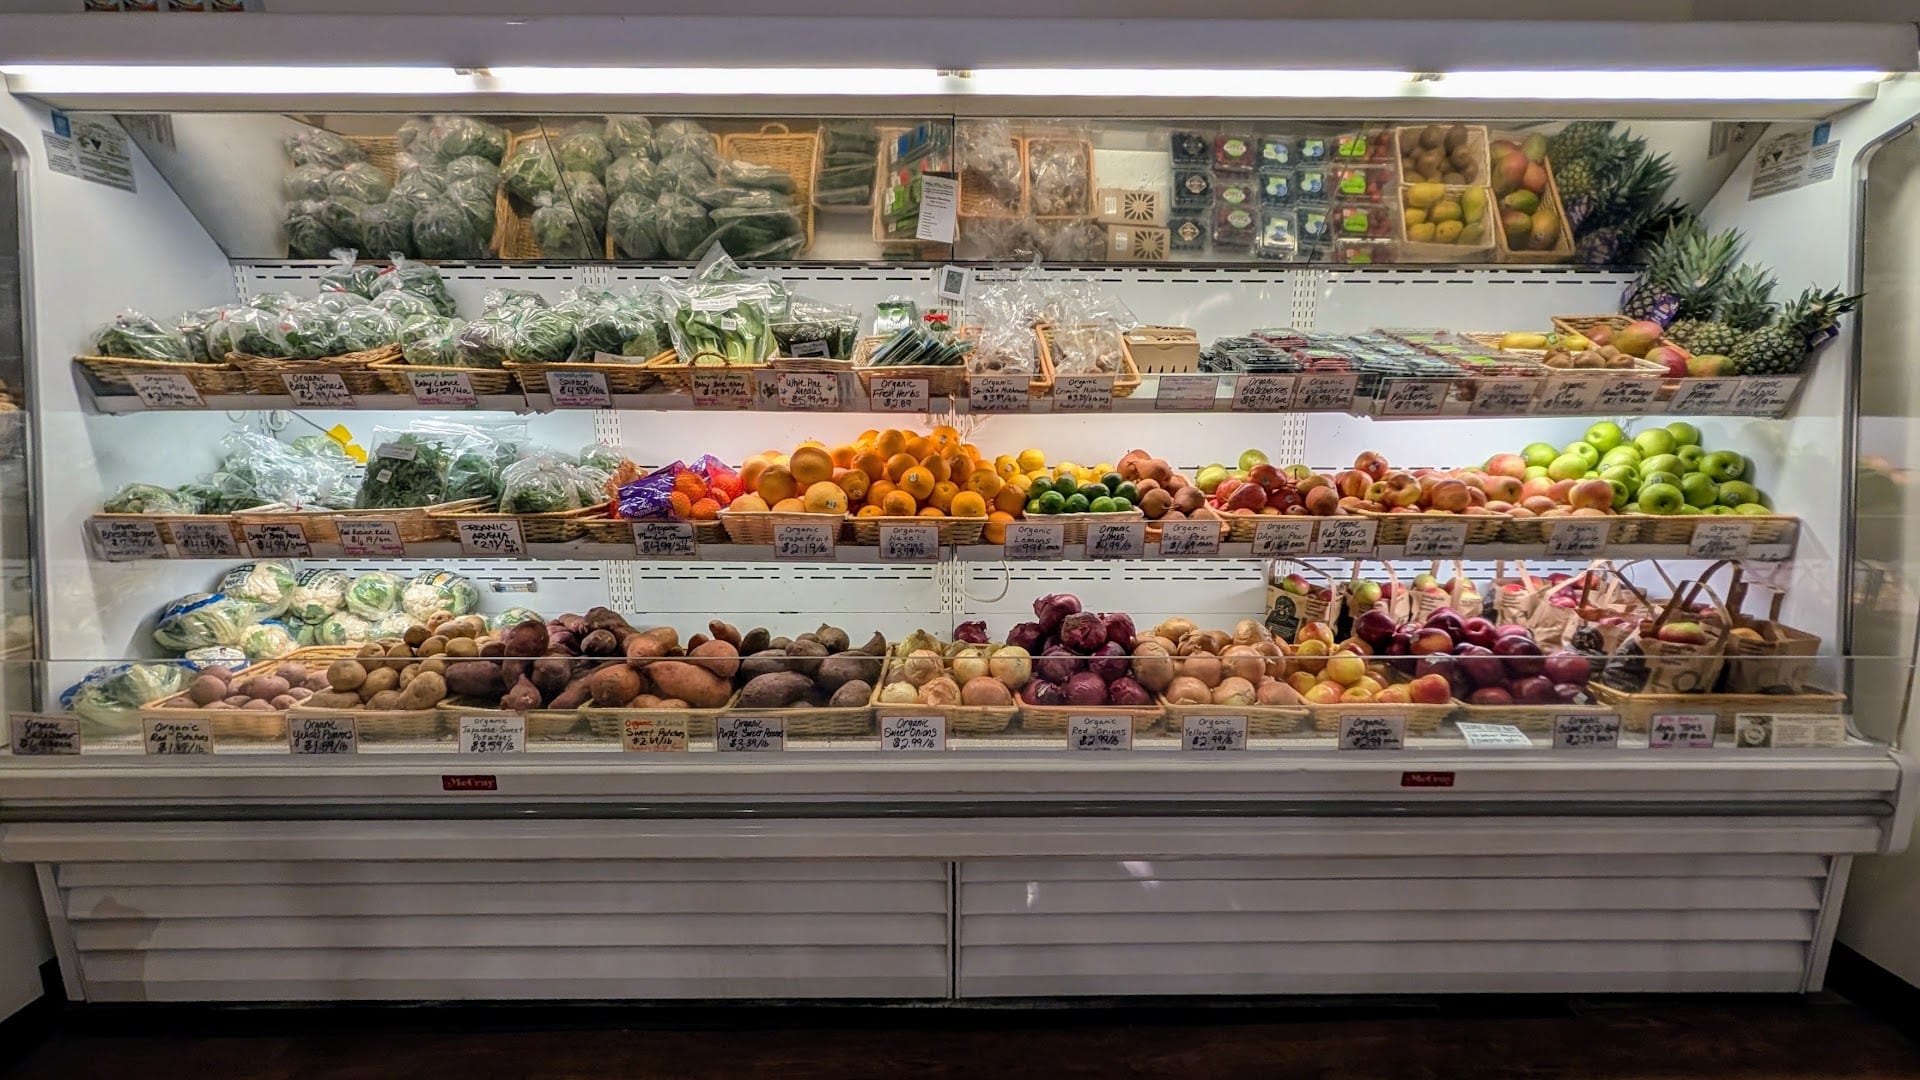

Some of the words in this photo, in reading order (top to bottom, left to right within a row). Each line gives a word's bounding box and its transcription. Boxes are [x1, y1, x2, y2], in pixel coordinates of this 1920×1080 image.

[293, 375, 327, 384] Organic
[415, 379, 432, 388] Baby
[560, 378, 588, 387] Spinach
[982, 379, 1012, 387] Organic
[1069, 379, 1096, 388] Organic
[1249, 378, 1277, 386] Organic
[1310, 378, 1344, 387] Organic
[290, 382, 310, 393] Baby
[314, 382, 344, 391] Spinach
[881, 380, 916, 390] Organic
[873, 388, 896, 398] Fresh
[897, 388, 920, 398] Herbs
[884, 400, 912, 409] $2.89
[786, 526, 819, 535] Organic
[893, 527, 927, 536] Organic
[1018, 526, 1052, 536] Organic
[1099, 524, 1130, 534] Organic
[1173, 523, 1208, 533] Organic
[1267, 523, 1301, 532] Organic
[1322, 529, 1336, 538] Red
[1339, 528, 1366, 538] Pears
[779, 535, 829, 544] Grapefruit
[1014, 536, 1052, 544] Lemons
[304, 720, 337, 730] Organic
[625, 719, 655, 730] Organic
[734, 719, 763, 729] Organic
[897, 718, 929, 730] Organic
[1084, 718, 1116, 730] Organic
[1199, 718, 1232, 728] Organic
[155, 723, 199, 735] Organic
[500, 725, 523, 734] Sweet
[626, 727, 654, 737] Sweet
[884, 728, 907, 738] Sweet
[909, 728, 937, 737] Onions
[1072, 727, 1087, 735] Red
[1096, 728, 1127, 736] Onions
[1185, 728, 1211, 736] Yellow
[1213, 728, 1244, 737] Onions
[150, 734, 167, 742] Red
[175, 733, 208, 742] Potatoes
[1080, 735, 1120, 746] $2.99/lb
[893, 738, 935, 750] $2.99/lb
[447, 778, 495, 789] McCray
